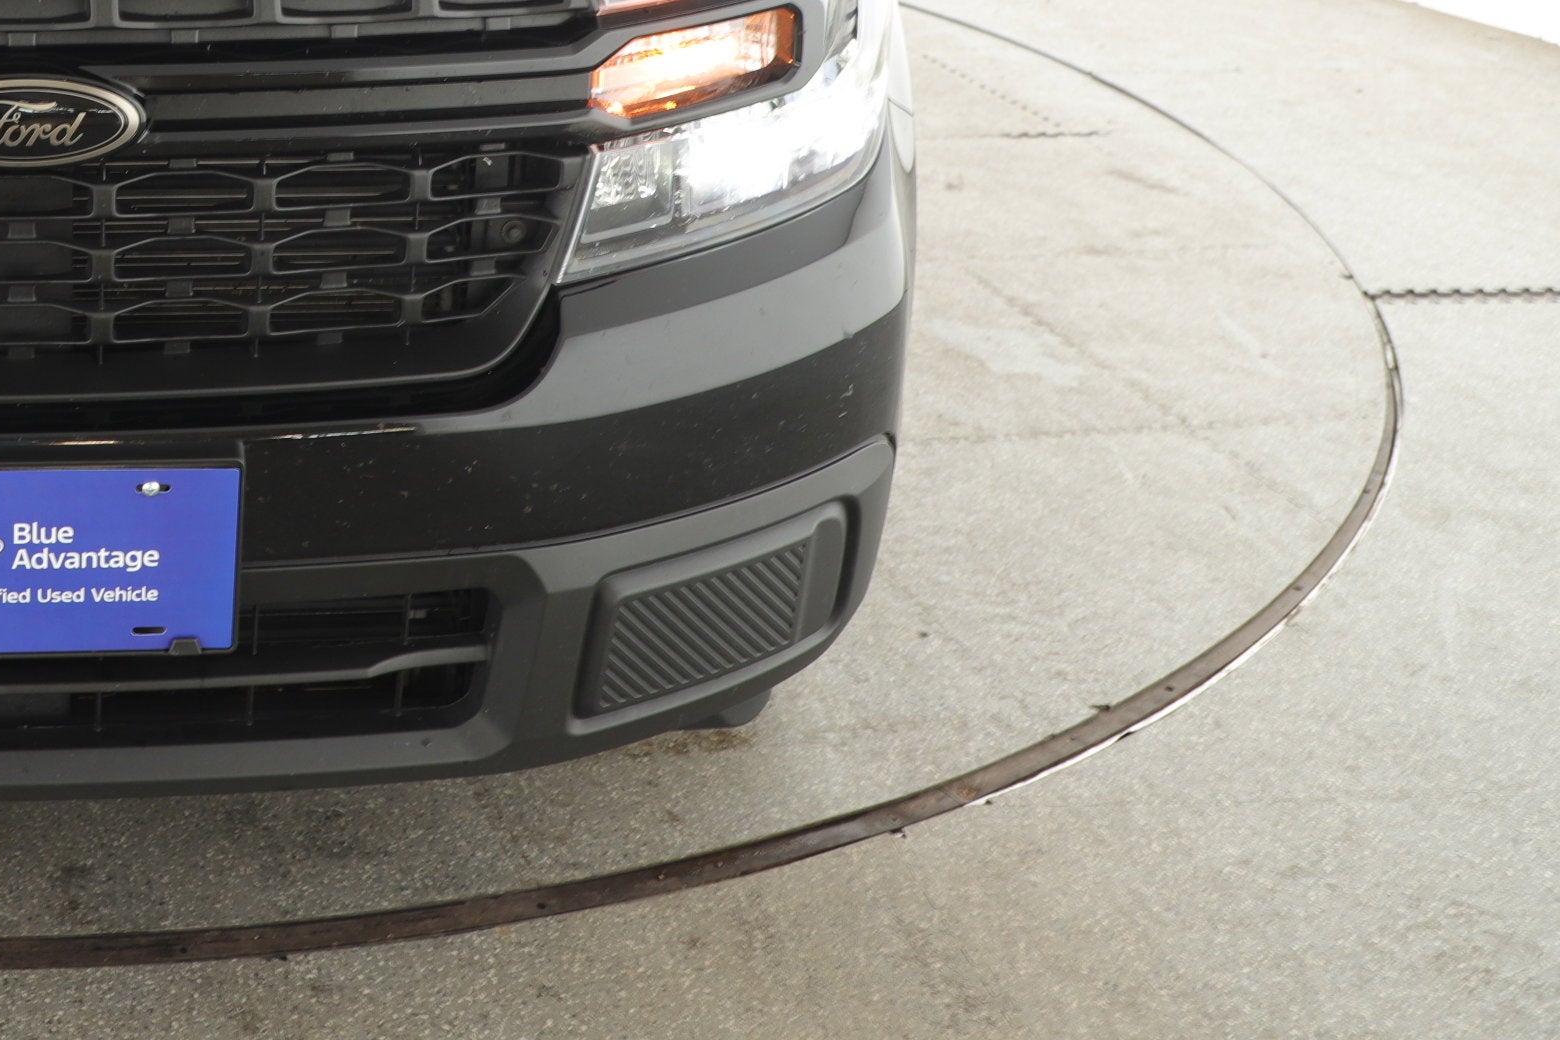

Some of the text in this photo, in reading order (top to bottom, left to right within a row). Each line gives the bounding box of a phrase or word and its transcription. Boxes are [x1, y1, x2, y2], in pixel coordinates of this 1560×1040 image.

[13, 522, 75, 545] Blue
[11, 547, 160, 572] Advantage
[37, 587, 86, 603] Used
[91, 586, 159, 603] Vehicle
